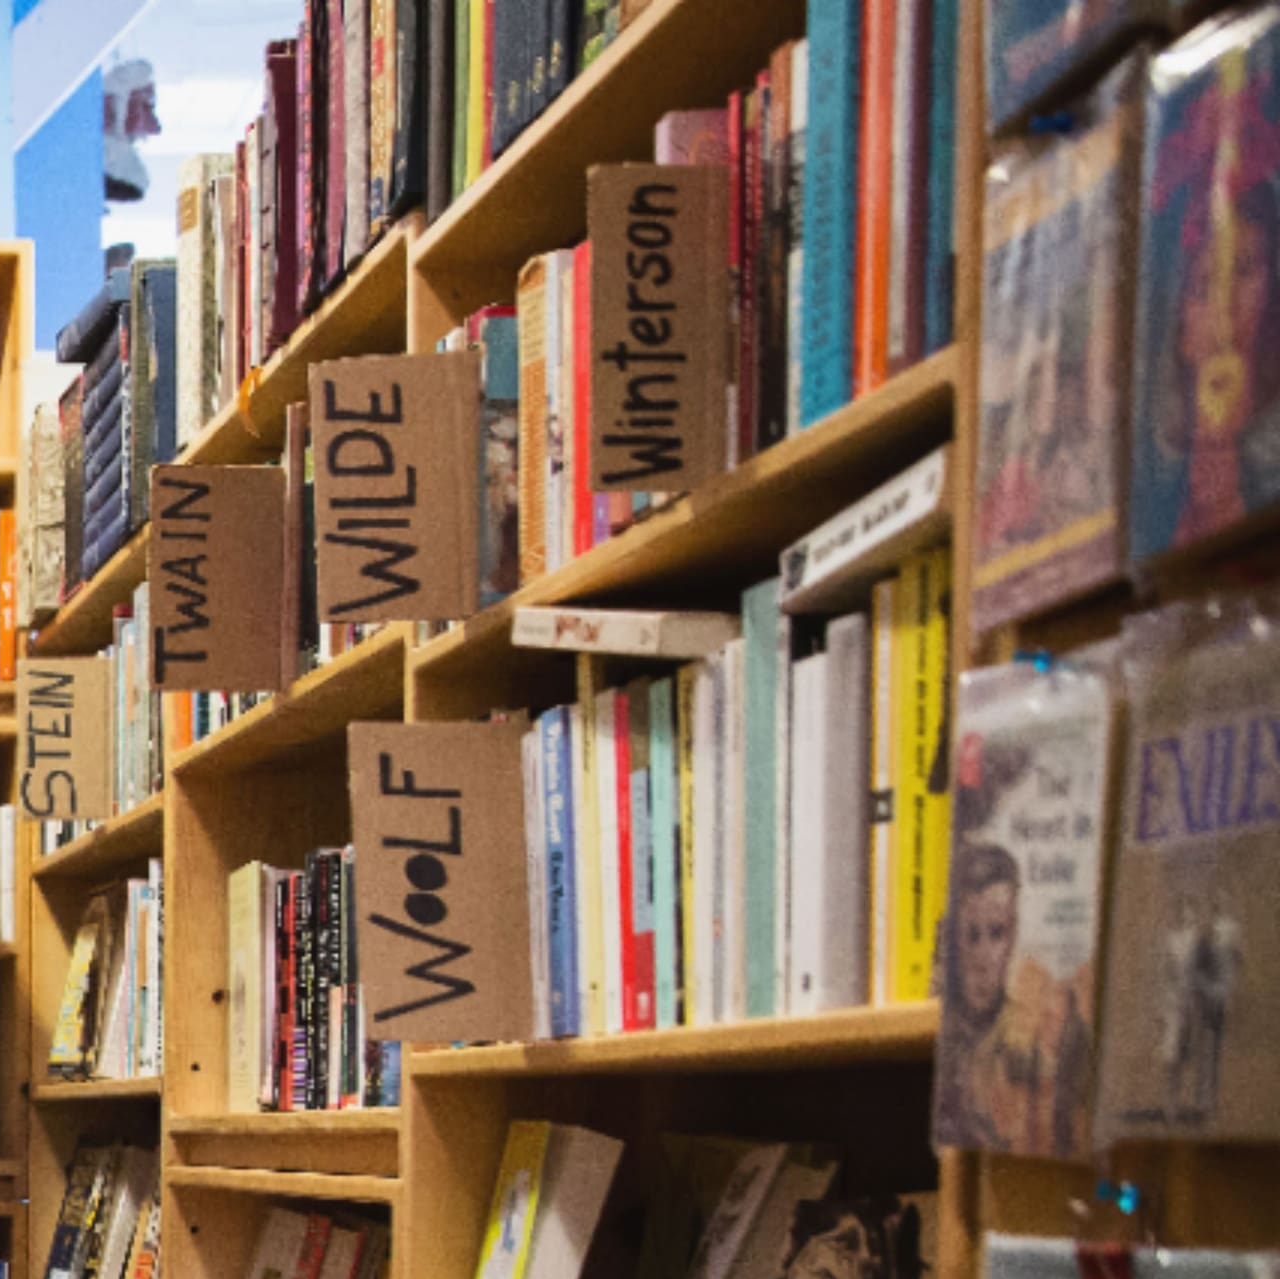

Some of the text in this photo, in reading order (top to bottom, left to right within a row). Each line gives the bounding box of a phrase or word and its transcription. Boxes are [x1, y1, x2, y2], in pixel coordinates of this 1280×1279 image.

[600, 181, 687, 487] Winterson
[153, 476, 212, 684] TWAIN
[323, 379, 421, 617] WILDE
[19, 668, 78, 819] STEIN
[368, 751, 477, 1023] WOOLF
